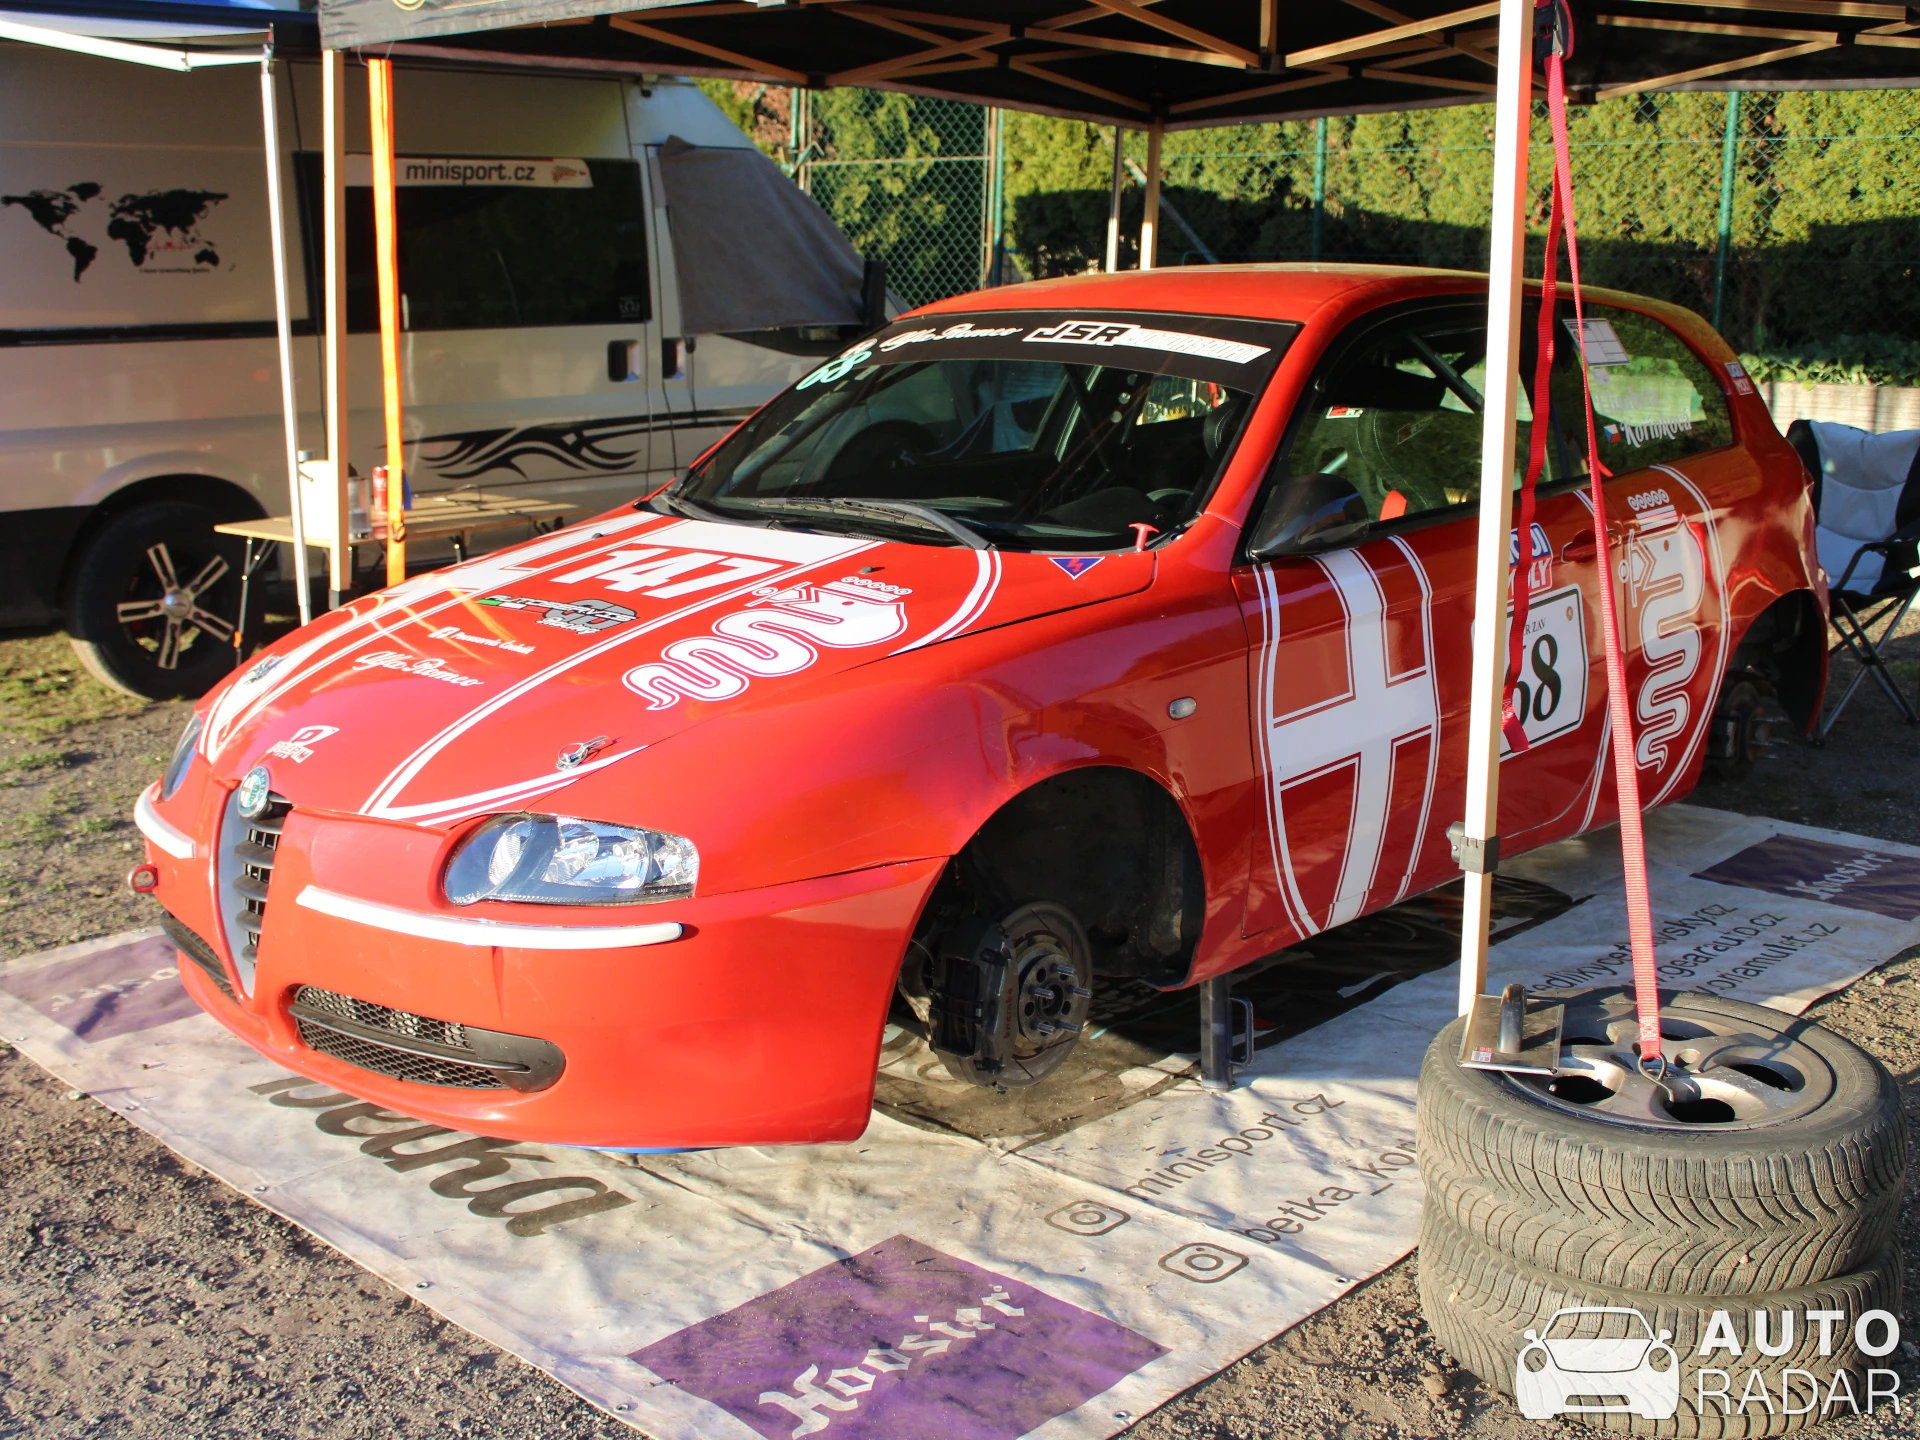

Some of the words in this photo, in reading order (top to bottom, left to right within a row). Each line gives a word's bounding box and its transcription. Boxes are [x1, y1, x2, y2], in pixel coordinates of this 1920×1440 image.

[405, 159, 536, 184] minisport.cz
[1024, 321, 1139, 346] JSR
[795, 350, 872, 390] 68
[549, 548, 784, 599] 147
[352, 651, 414, 671] Alfa
[402, 658, 484, 686] Romeo
[1004, 987, 1014, 1039] brembo
[1124, 1094, 1346, 1196] minisport.cz
